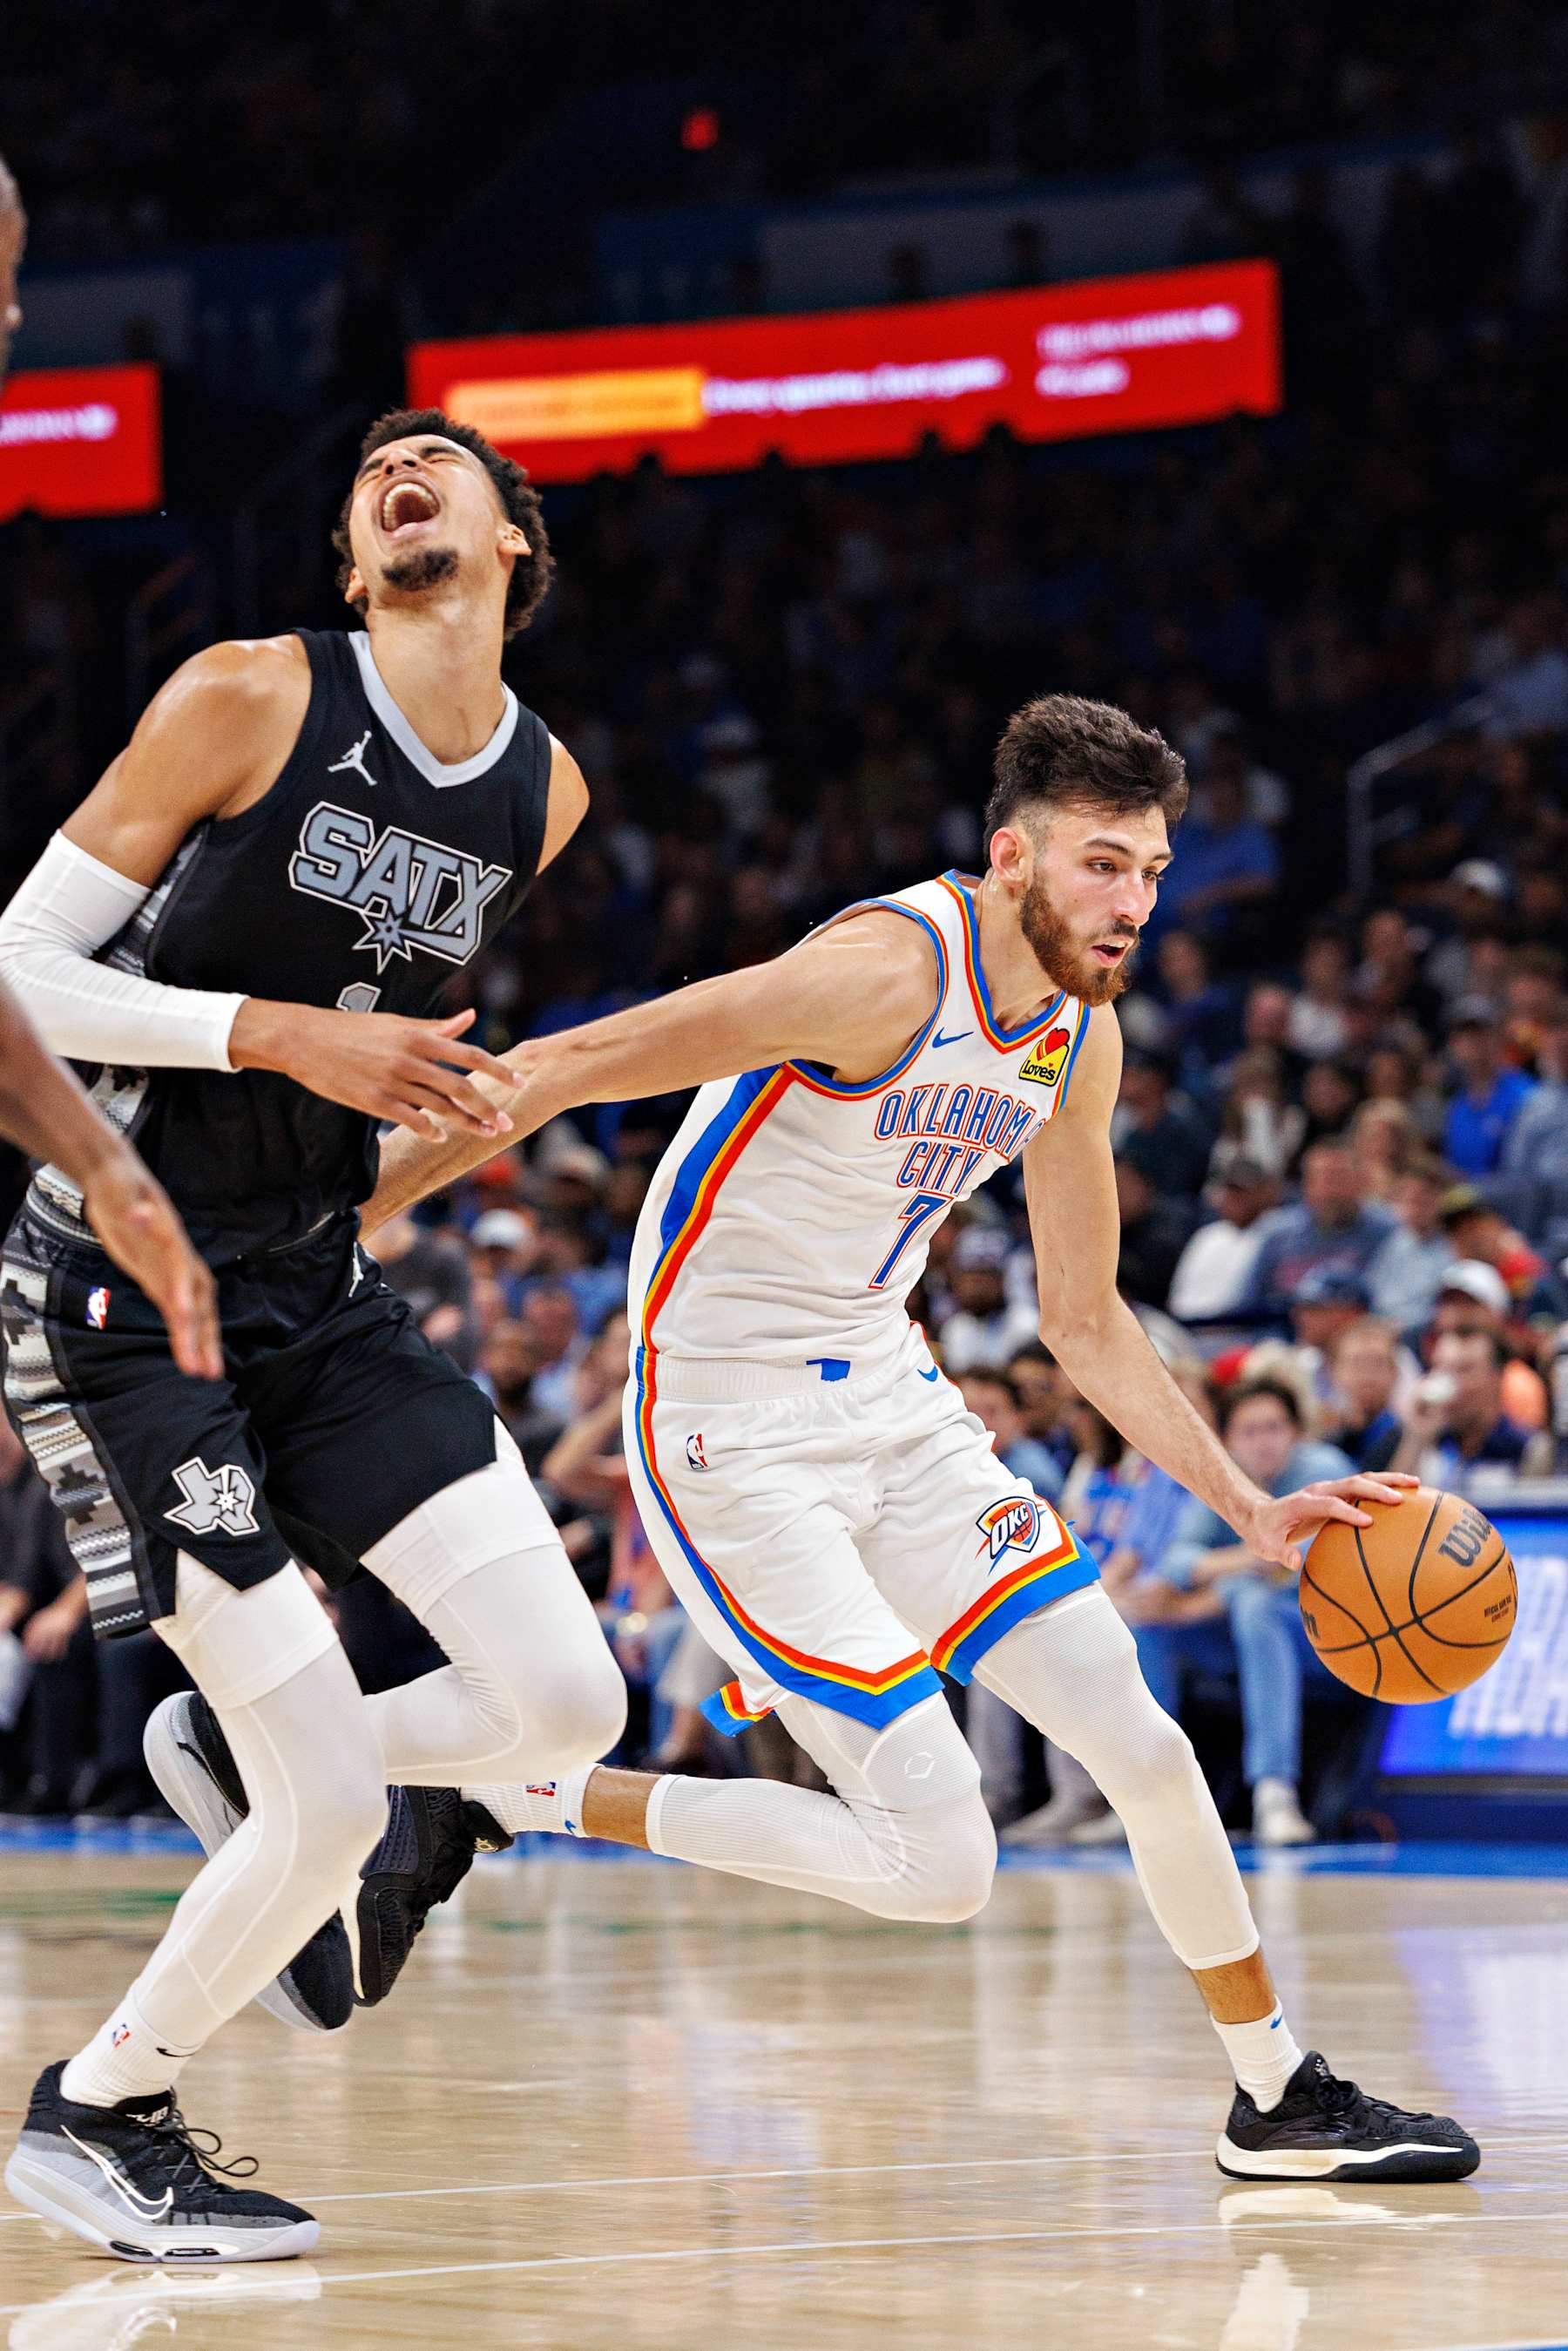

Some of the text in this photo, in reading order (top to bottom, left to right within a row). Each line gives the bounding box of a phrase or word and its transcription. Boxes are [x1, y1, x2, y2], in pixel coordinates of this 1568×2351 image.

[288, 801, 513, 966] SATX
[896, 1141, 987, 1197] CITY
[868, 1189, 955, 1289] 7
[990, 1504, 1030, 1560] OKC
